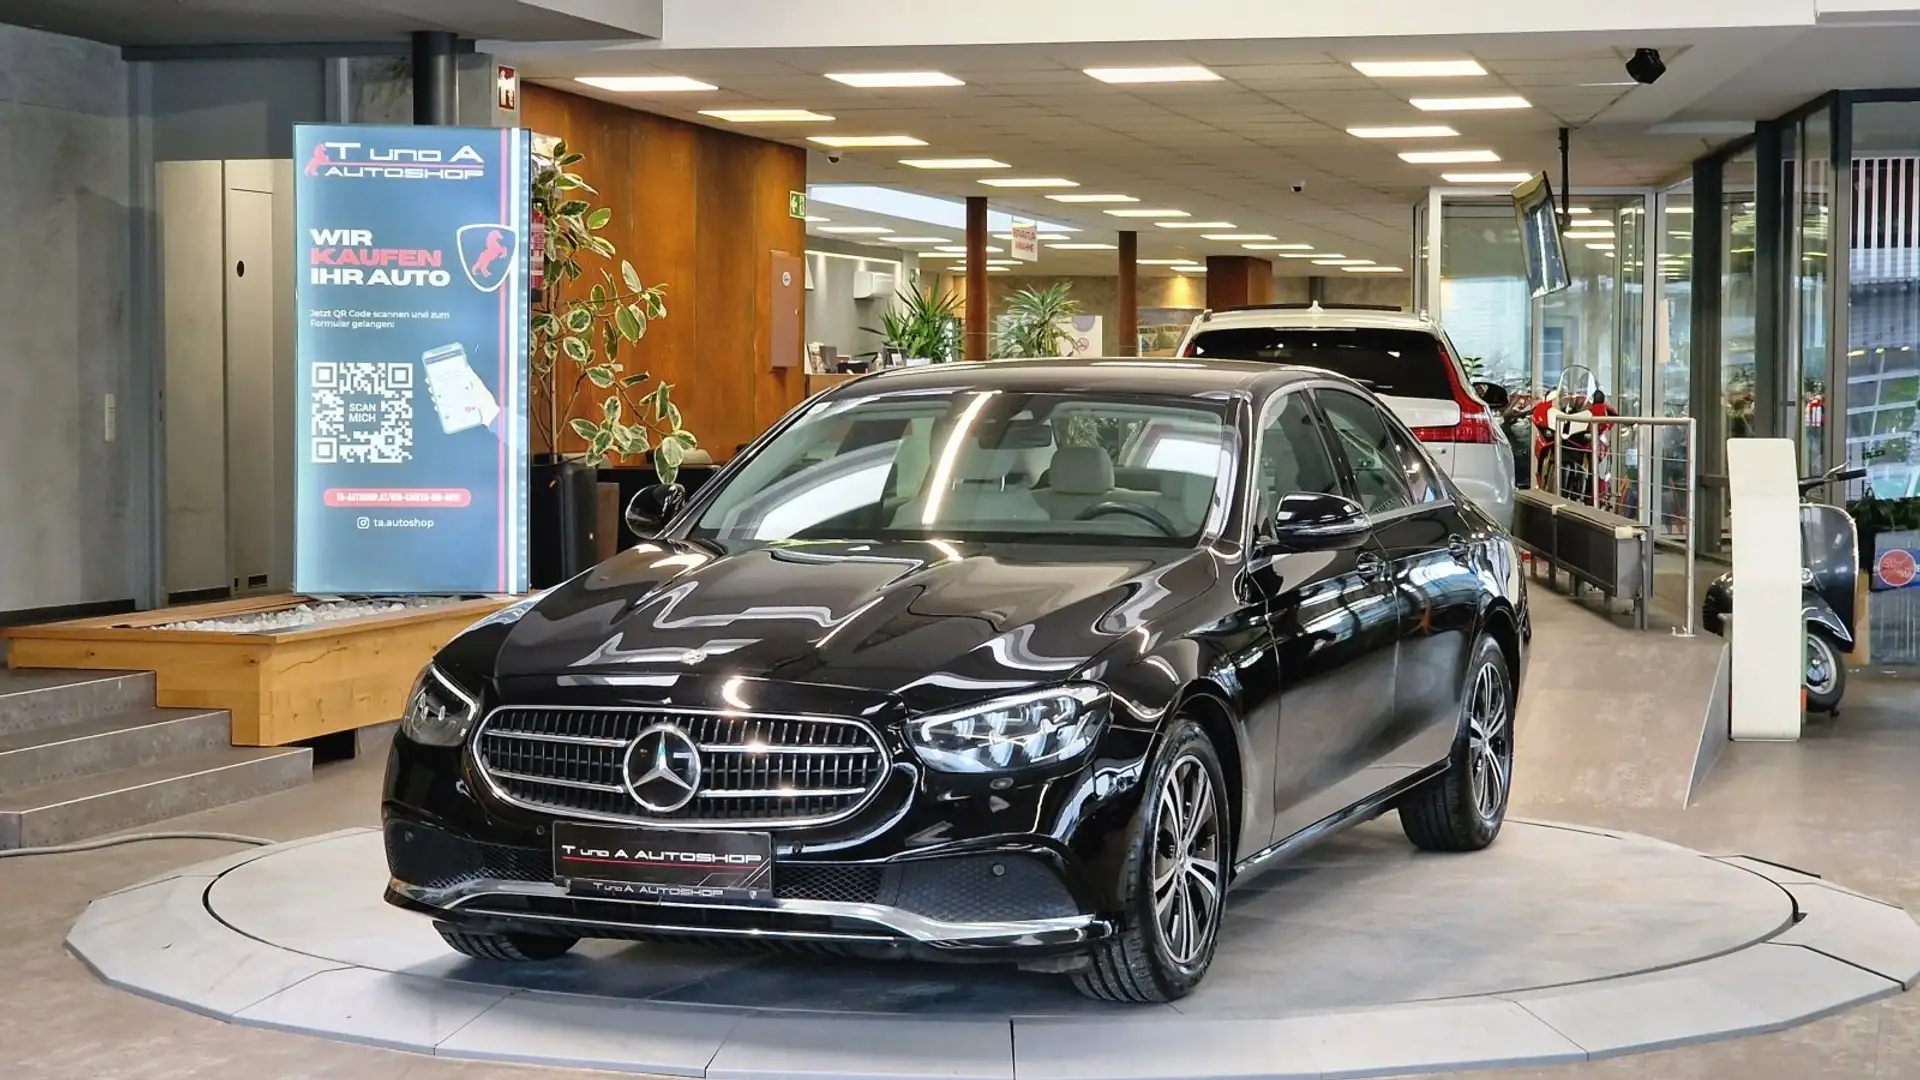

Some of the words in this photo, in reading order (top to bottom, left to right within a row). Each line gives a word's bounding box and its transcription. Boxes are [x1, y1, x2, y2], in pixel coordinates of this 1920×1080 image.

[325, 142, 361, 159] T
[449, 145, 485, 163] A
[325, 166, 484, 180] AUTOSHOP
[310, 228, 373, 246] WIR
[311, 248, 442, 267] KAUFEN
[310, 267, 364, 285] IHR
[367, 269, 451, 287] AUTO
[309, 310, 331, 318] Jetzt
[333, 310, 347, 319] QR
[348, 310, 372, 318] Code
[373, 311, 410, 319] scannen
[411, 311, 429, 319] und
[310, 320, 350, 328] Formular
[348, 403, 377, 412] SCAN
[348, 413, 377, 423] MICH
[373, 518, 435, 529] ta.autoshop
[561, 845, 576, 855] T
[614, 849, 629, 859] A
[635, 850, 762, 864] AUTOSHOP
[593, 882, 603, 890] T
[624, 885, 634, 893] A
[639, 886, 724, 897] AUTOSHOP
